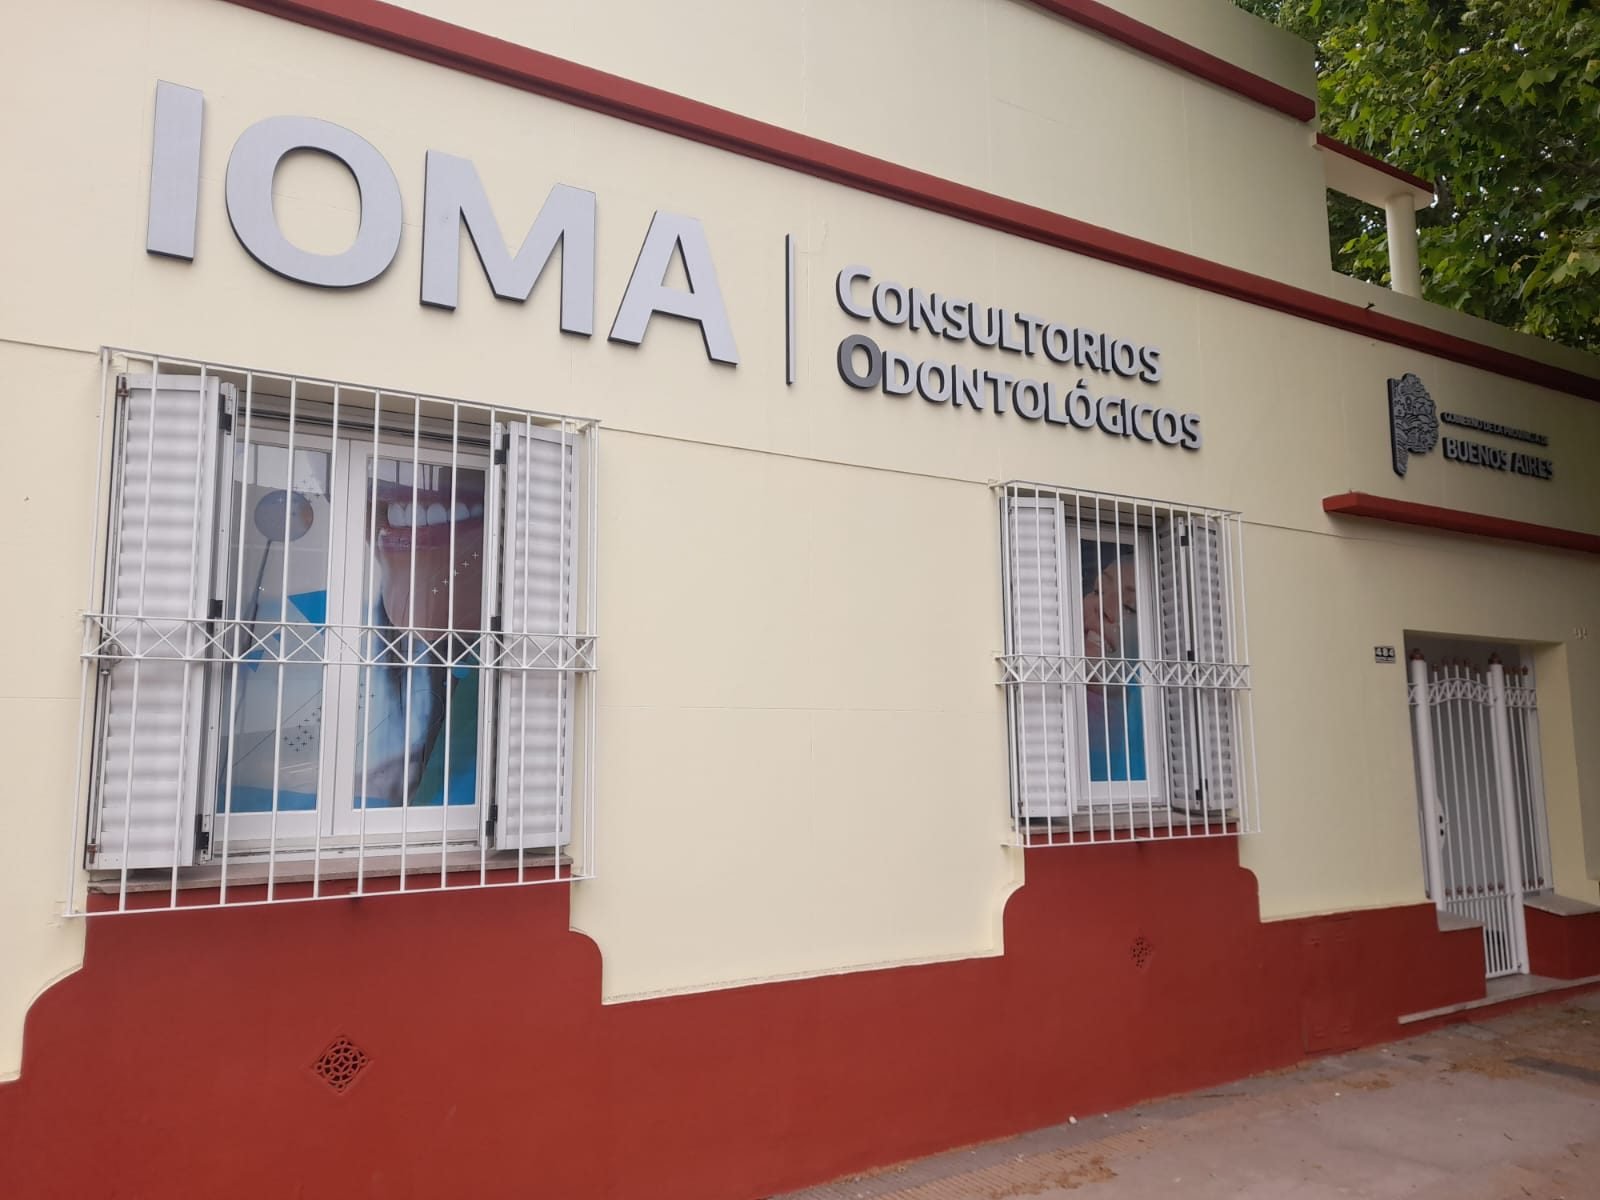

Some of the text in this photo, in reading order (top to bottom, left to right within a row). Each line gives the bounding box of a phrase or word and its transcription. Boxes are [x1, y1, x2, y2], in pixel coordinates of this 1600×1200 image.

[146, 79, 738, 366] IOMA
[836, 264, 1162, 383] CONSULTORIOS
[837, 334, 1202, 450] ODONTOLÓGICOS
[1442, 437, 1552, 480] BUENOS AIRES
